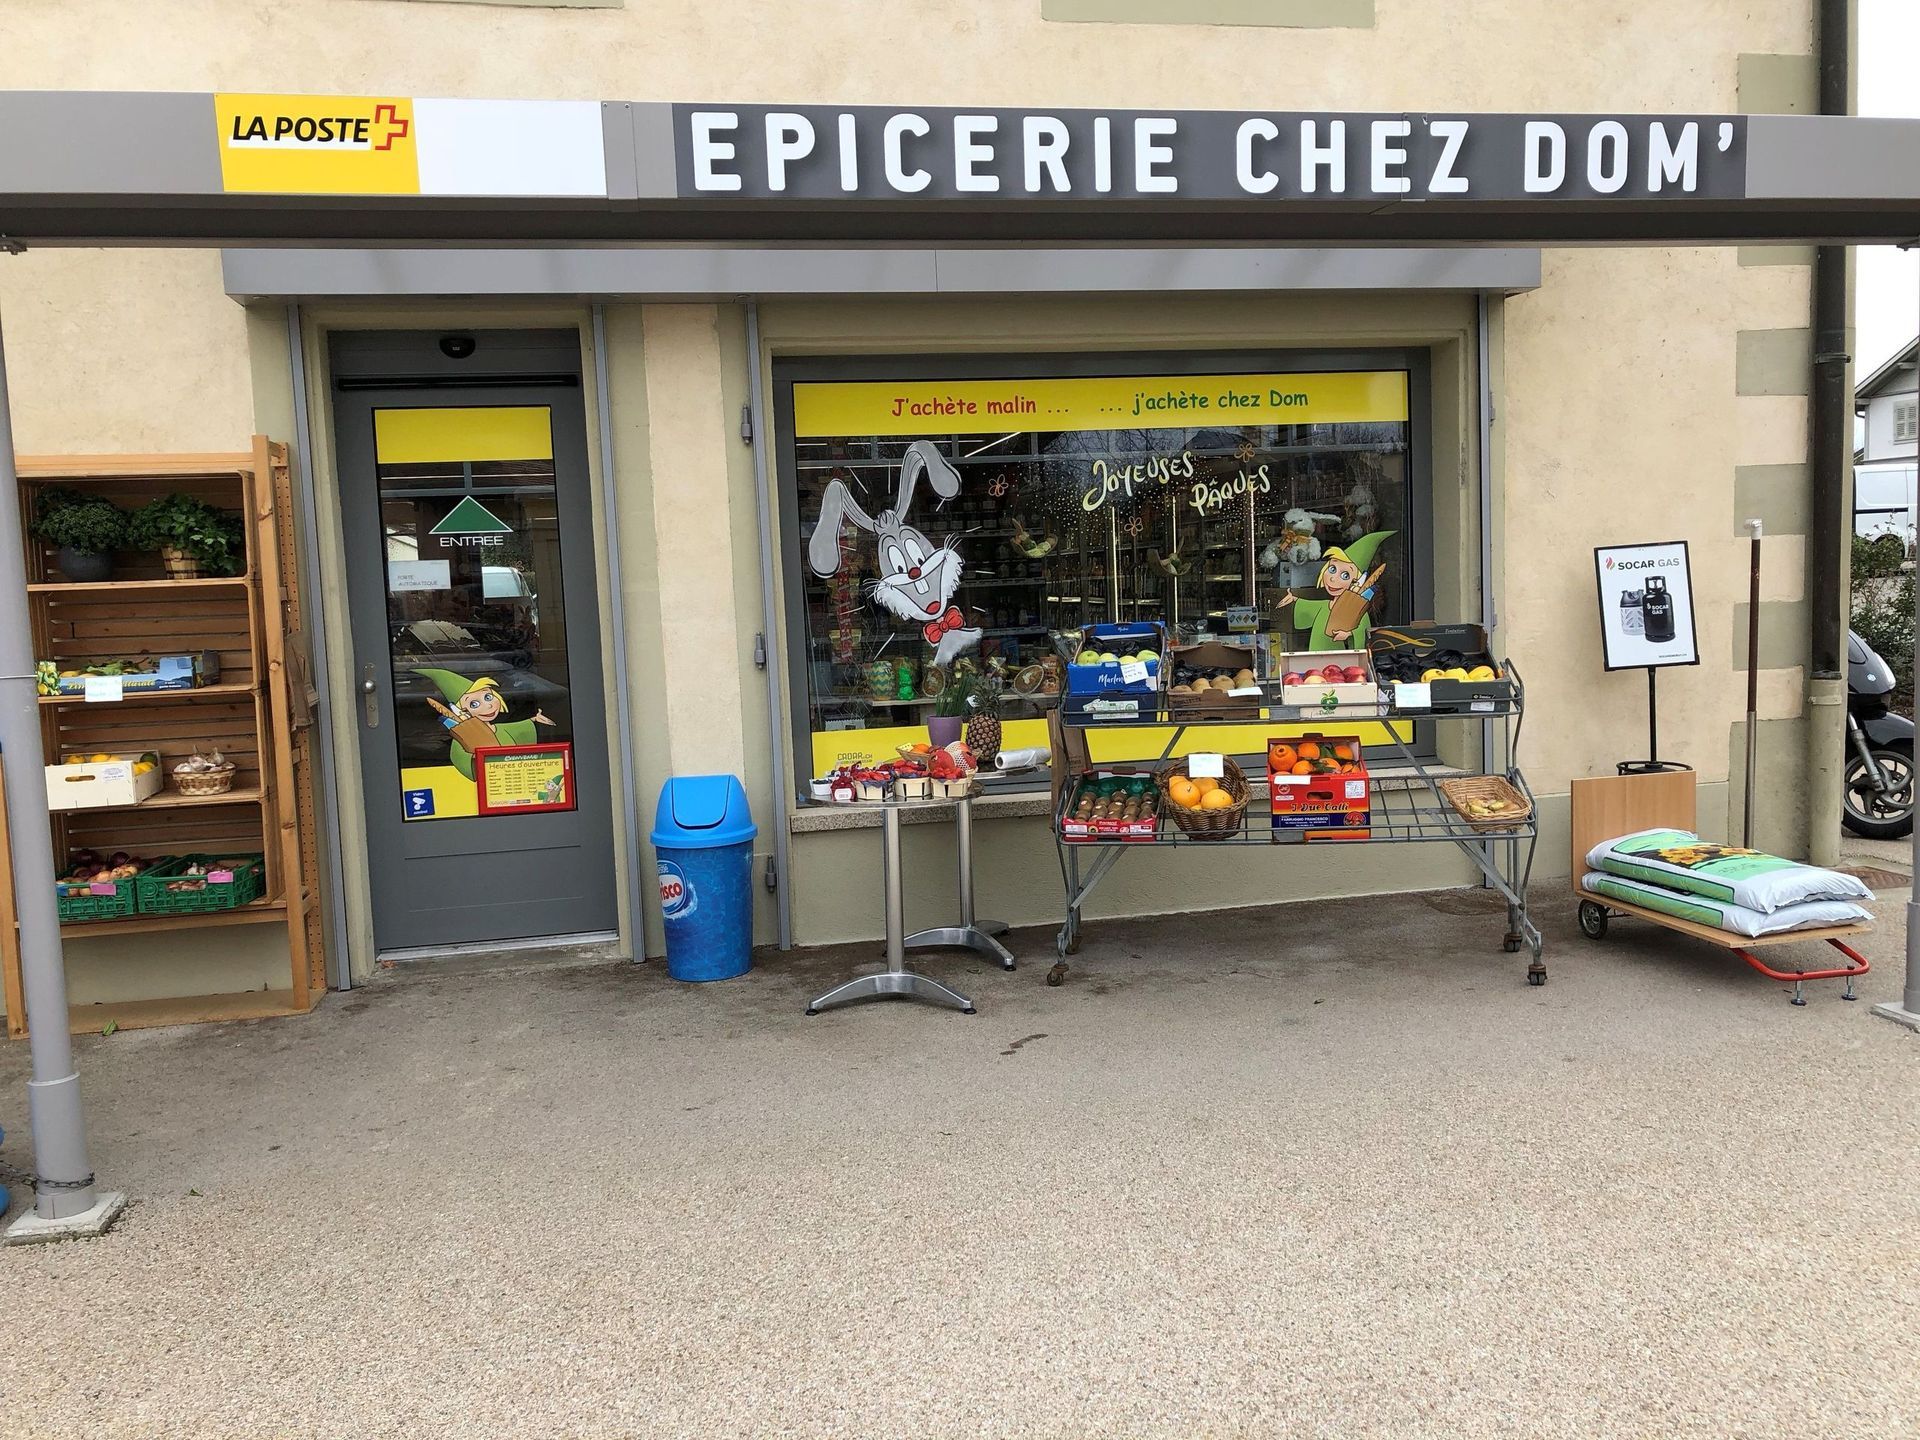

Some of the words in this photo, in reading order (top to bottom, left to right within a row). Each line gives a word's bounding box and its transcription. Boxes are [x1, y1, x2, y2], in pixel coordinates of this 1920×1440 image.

[232, 115, 268, 141] LA
[274, 116, 371, 143] POSTE
[691, 112, 1179, 193] EPICERIE
[1236, 118, 1469, 194] CHEZ
[1524, 120, 1734, 194] DOM'
[892, 397, 978, 417] J'achète
[987, 394, 1037, 415] malin
[1132, 391, 1210, 417] j'achète
[1218, 390, 1261, 409] chez
[1270, 389, 1309, 407] Dom
[440, 535, 504, 548] ENTREE
[1618, 559, 1655, 571] SOCAR
[1657, 557, 1680, 568] GAS
[1098, 673, 1124, 687] Marlen
[489, 762, 516, 770] Heures
[517, 760, 560, 769] d'ouverture
